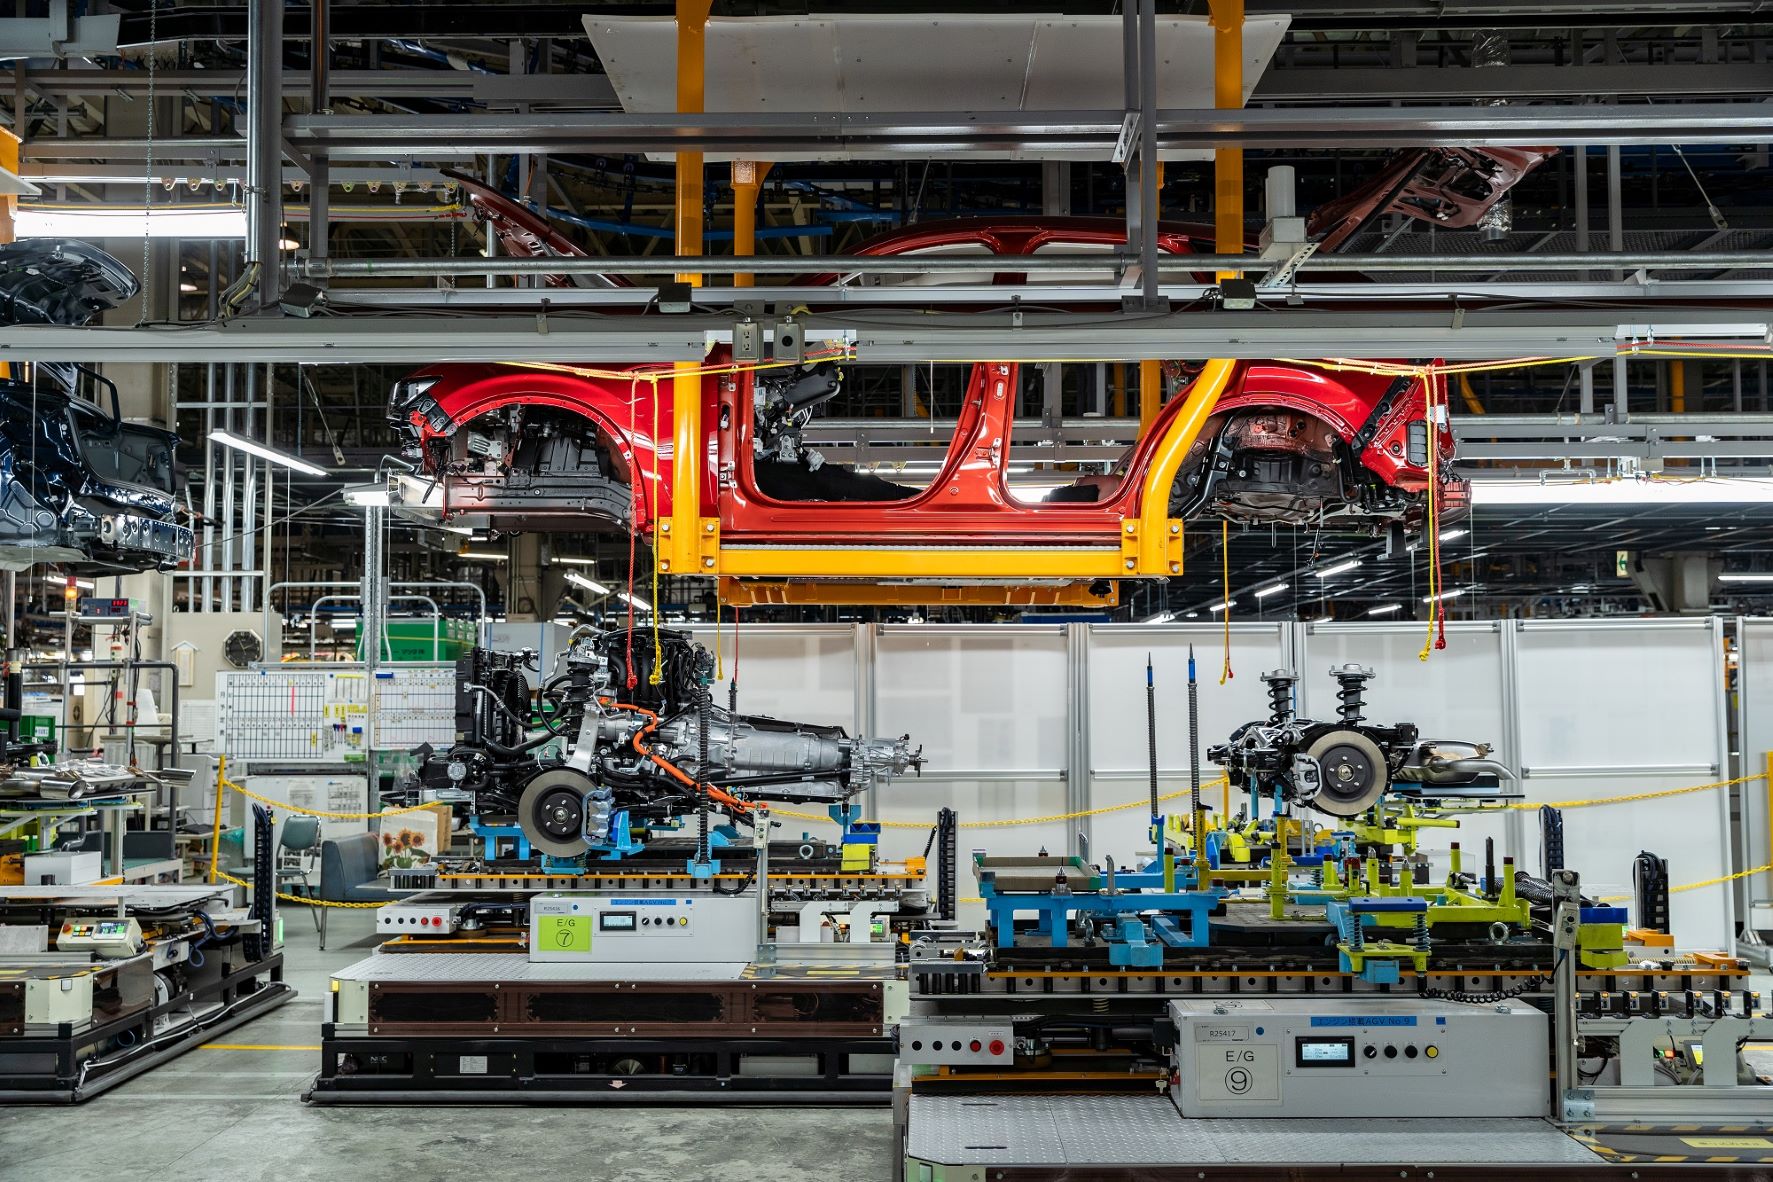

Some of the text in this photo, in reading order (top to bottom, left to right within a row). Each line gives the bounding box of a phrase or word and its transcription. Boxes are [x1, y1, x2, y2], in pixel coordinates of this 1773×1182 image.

[556, 918, 576, 927] E/G
[1209, 1030, 1237, 1038] R25417
[1225, 1050, 1254, 1063] E/G
